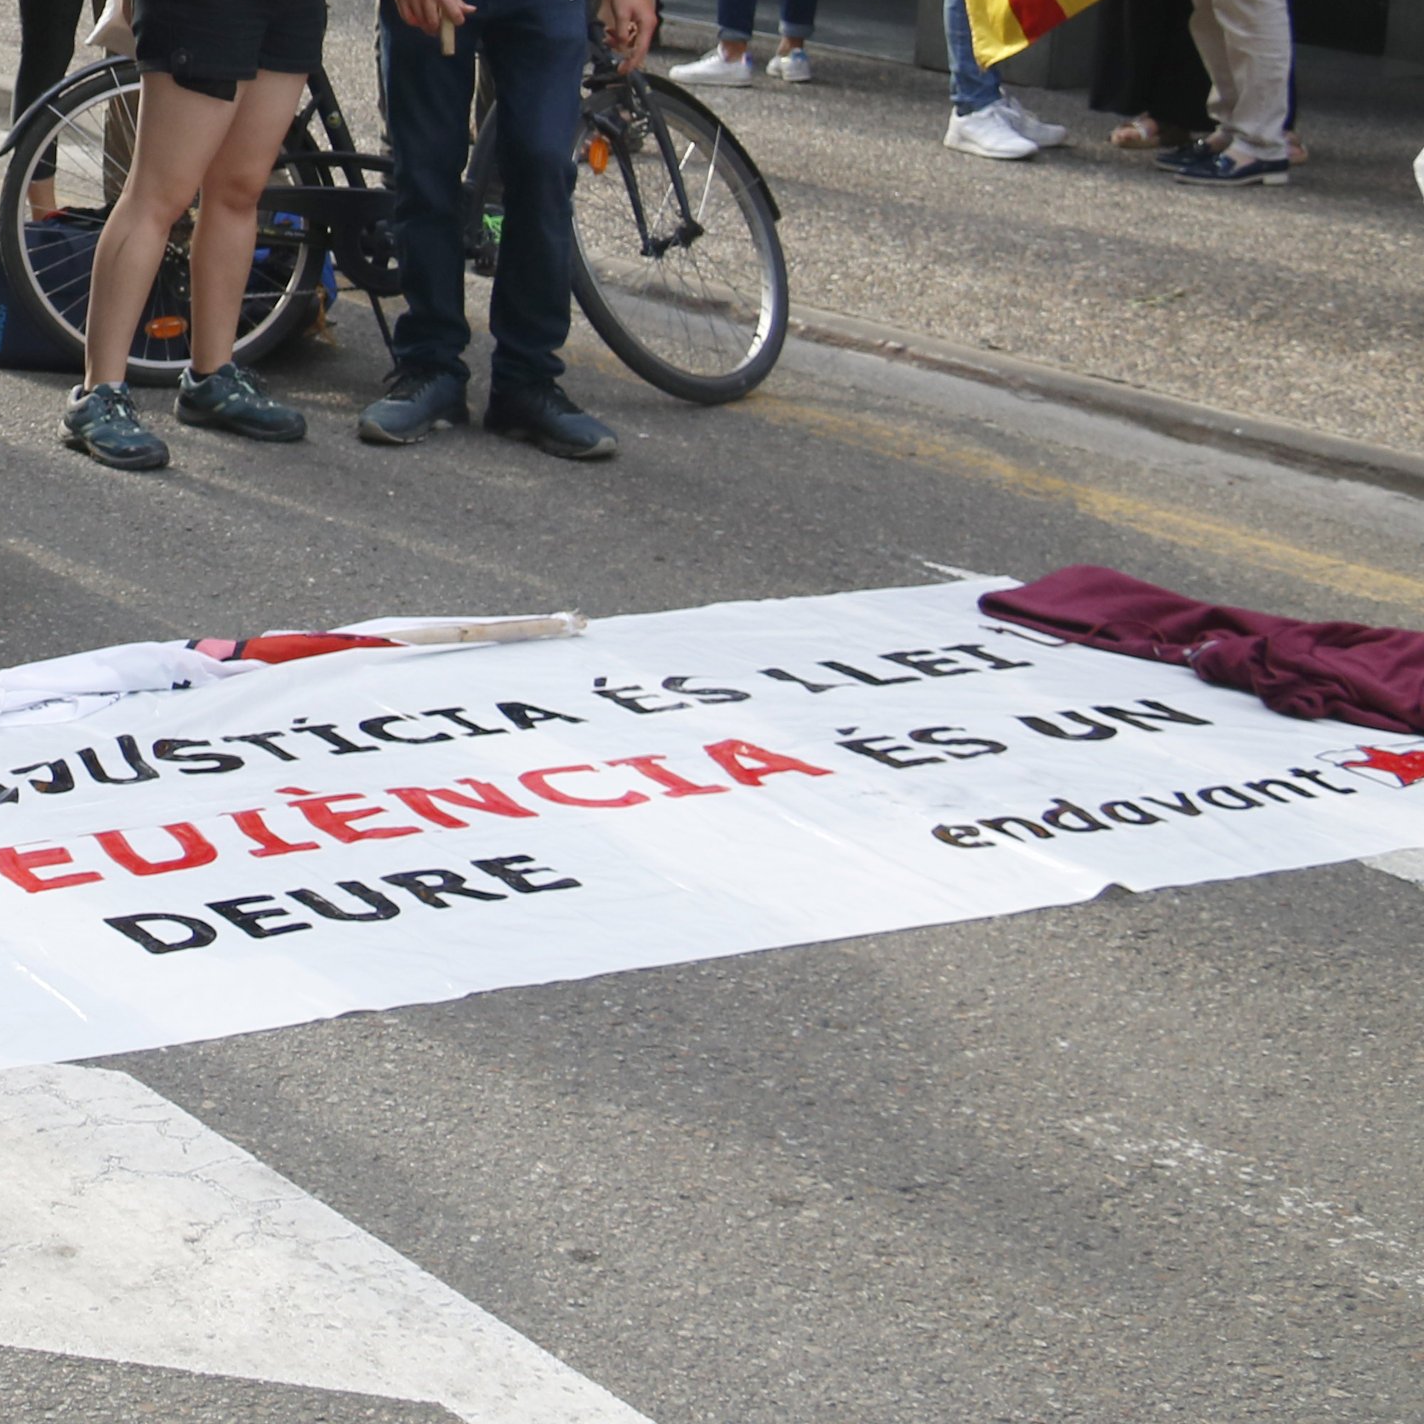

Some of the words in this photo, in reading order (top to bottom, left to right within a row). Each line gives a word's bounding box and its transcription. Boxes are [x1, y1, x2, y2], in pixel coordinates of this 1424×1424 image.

[835, 726, 1009, 770] ÉS
[1014, 698, 1215, 741] UN
[930, 767, 1357, 849] endavant
[103, 854, 583, 955] DEURE
